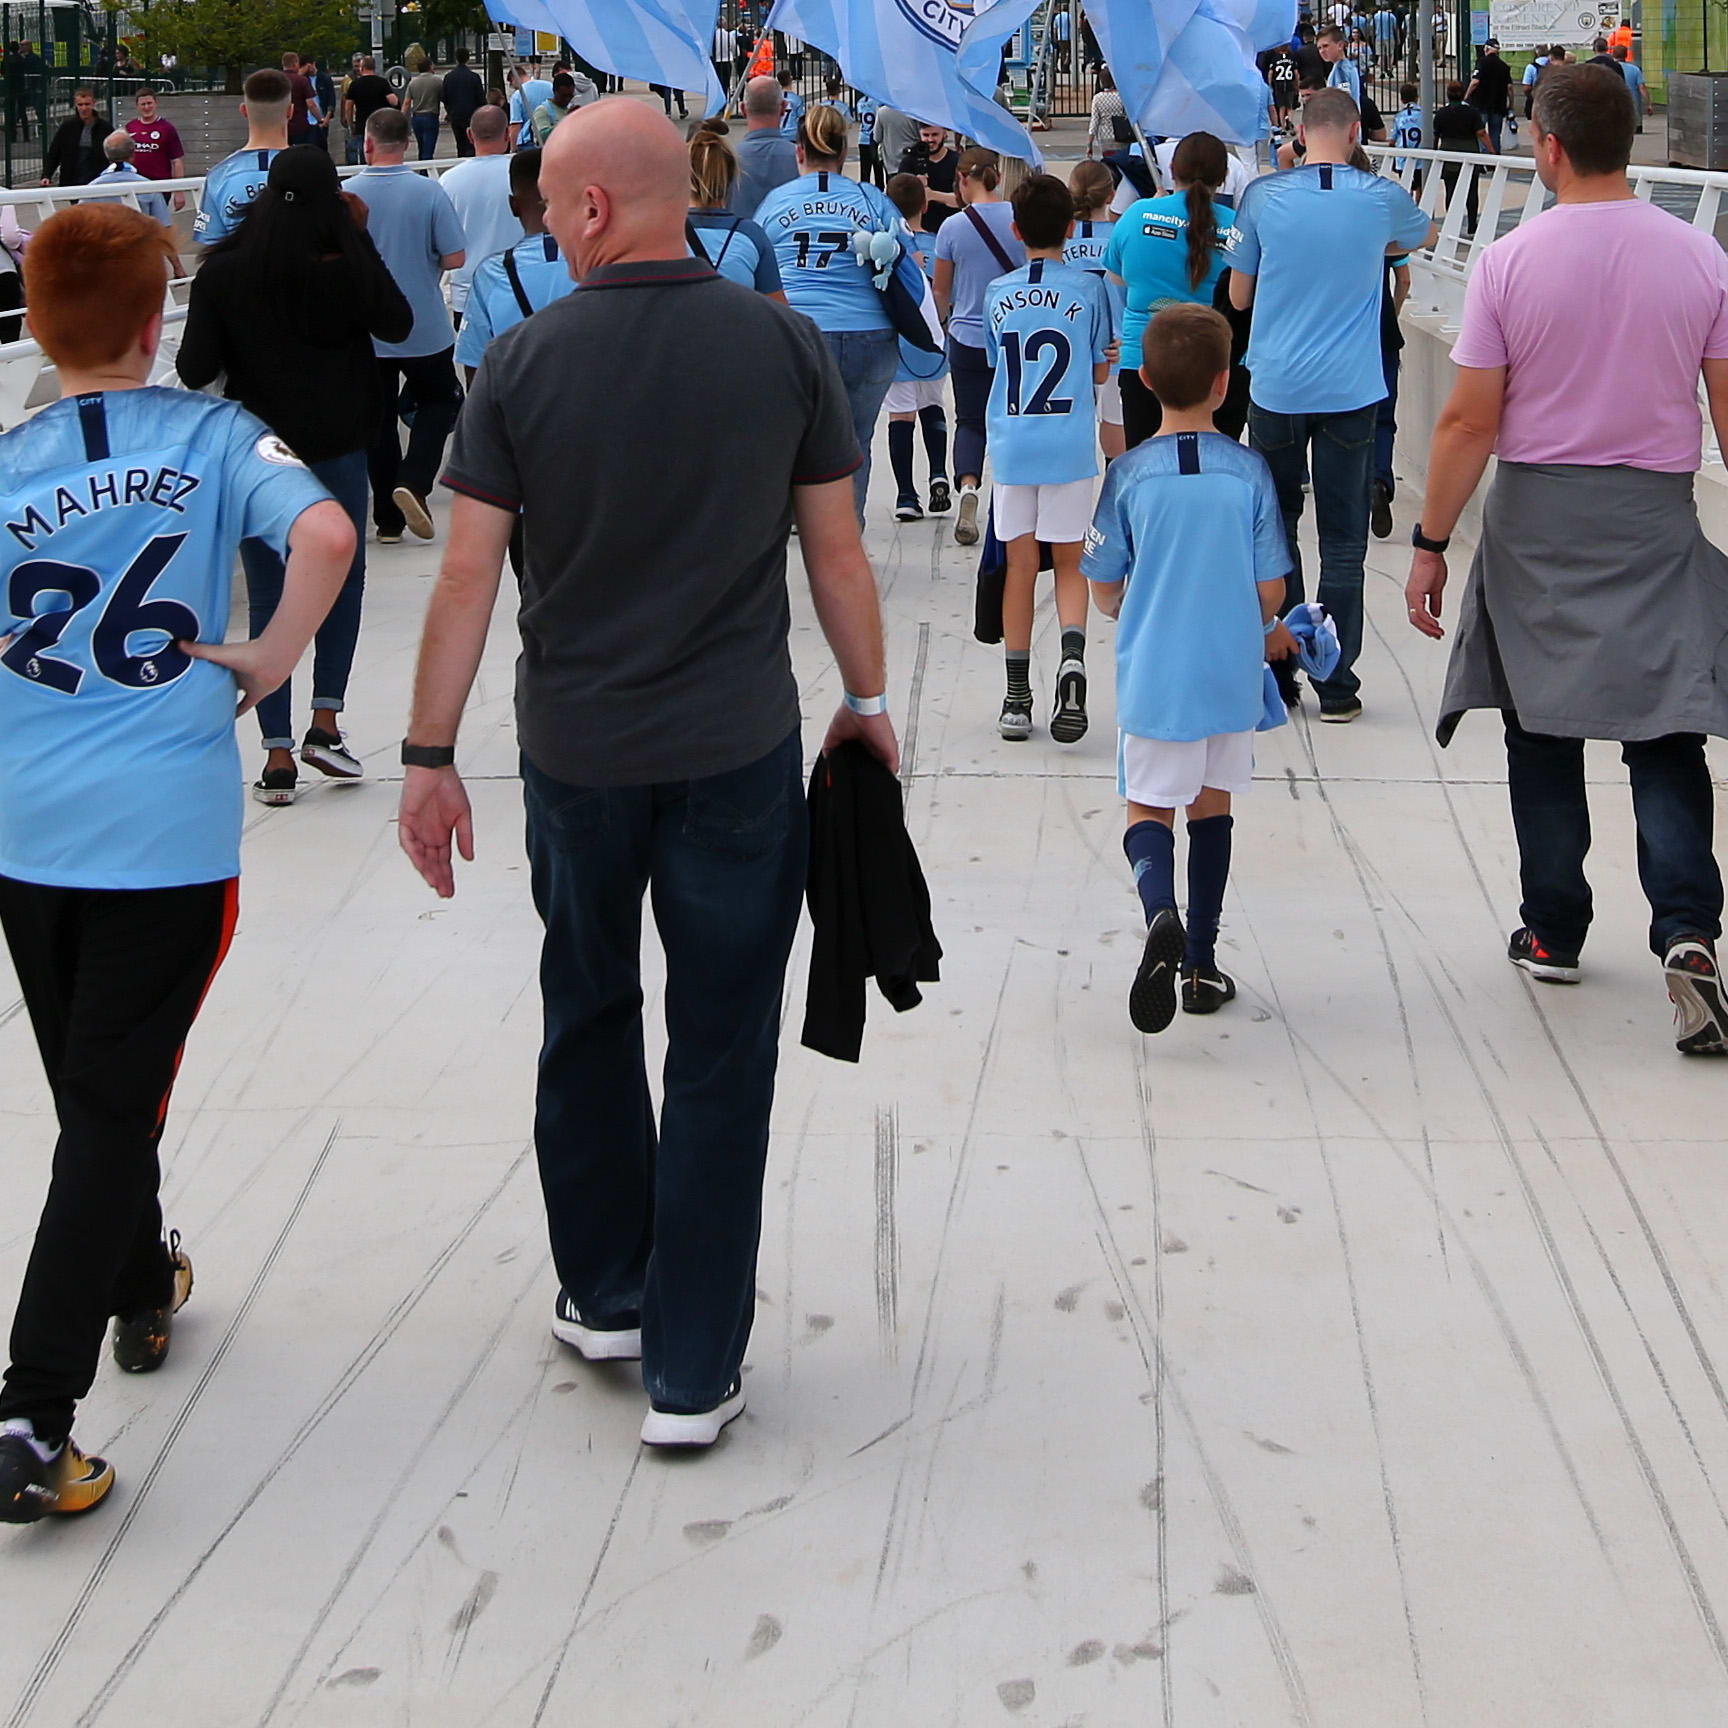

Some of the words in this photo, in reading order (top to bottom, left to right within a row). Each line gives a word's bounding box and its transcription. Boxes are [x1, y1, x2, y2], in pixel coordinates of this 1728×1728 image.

[1275, 64, 1293, 81] 26
[1399, 127, 1422, 149] 19
[778, 208, 800, 229] DE
[803, 201, 871, 229] BRUYNE
[792, 232, 849, 269] 17
[992, 289, 1060, 331] JENSON
[1064, 302, 1083, 322] K
[999, 328, 1074, 417] 12
[78, 397, 103, 408] CITY
[5, 466, 201, 552] MAHREZ
[0, 529, 202, 697] 26
